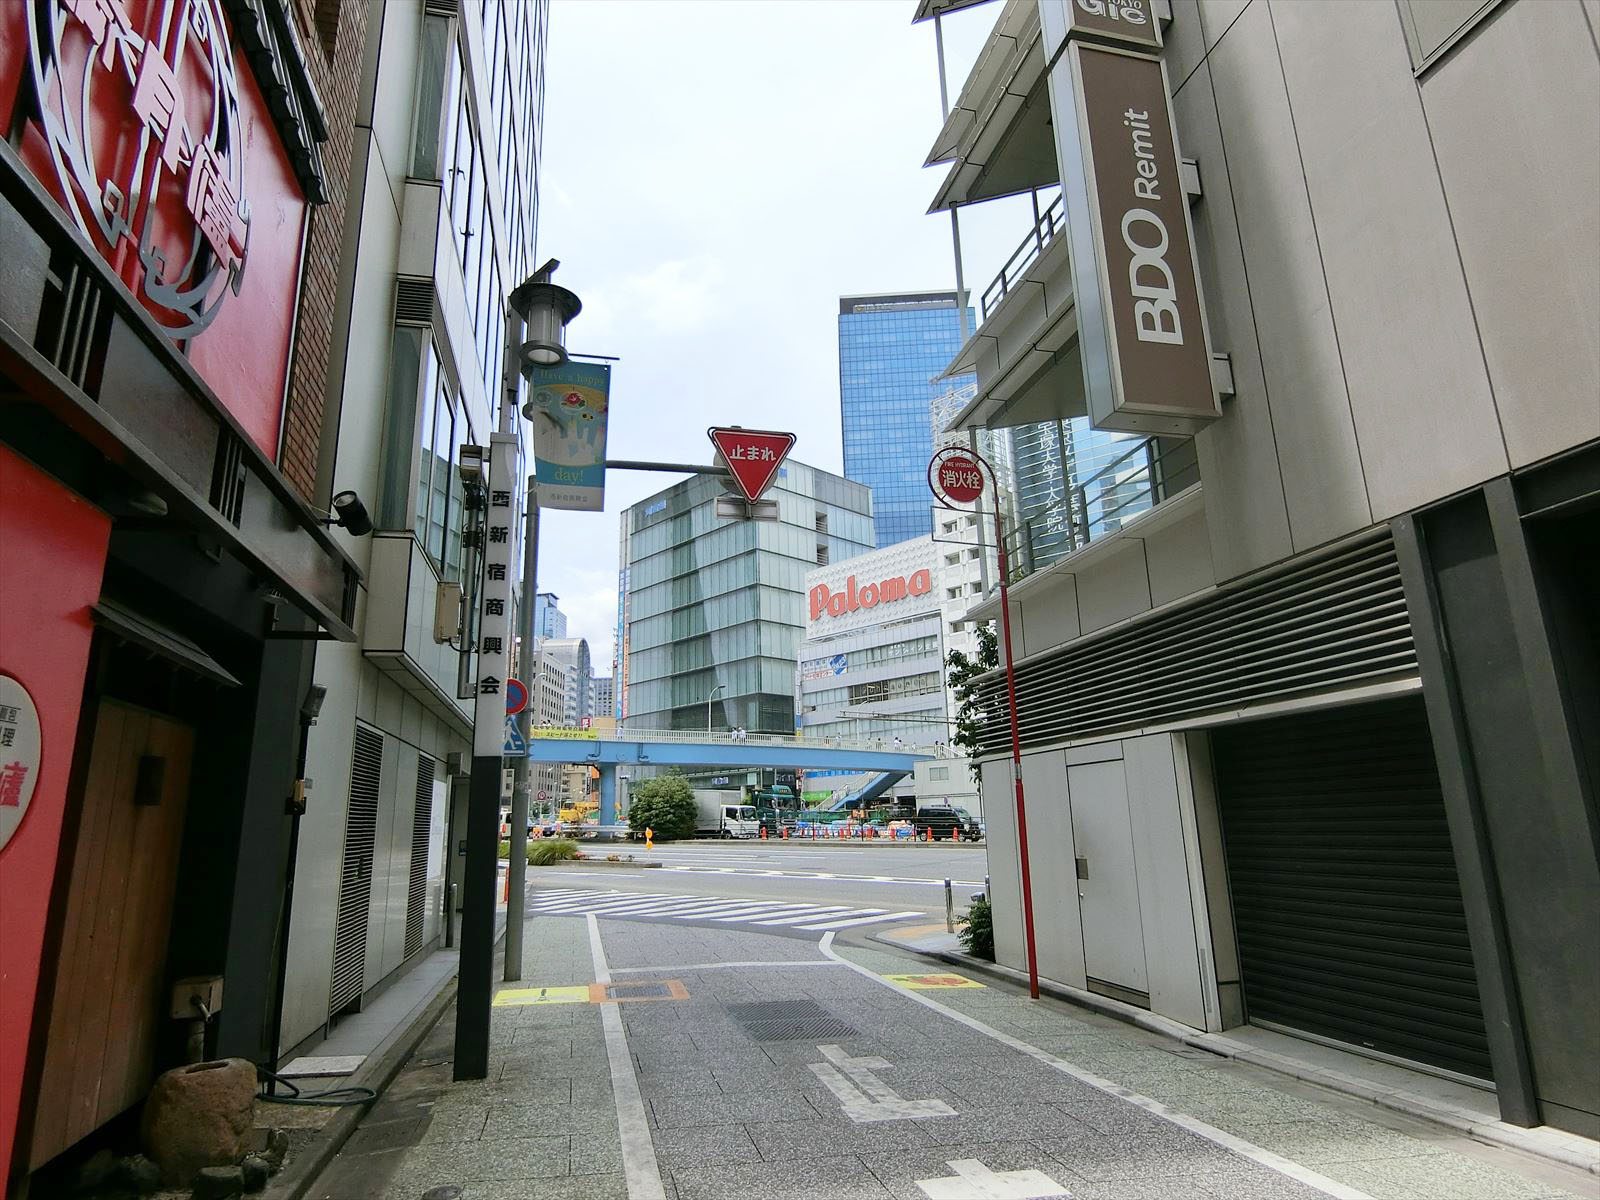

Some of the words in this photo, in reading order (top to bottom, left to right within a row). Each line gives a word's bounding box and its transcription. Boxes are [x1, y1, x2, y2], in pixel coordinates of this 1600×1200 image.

[1123, 108, 1161, 200] Remit
[1121, 208, 1184, 345] BDO
[554, 466, 584, 484] day!
[730, 444, 777, 461] 止まれ
[942, 469, 981, 489] 消火栓
[480, 490, 511, 695] 西新宿商興会
[809, 568, 931, 622] Paloma
